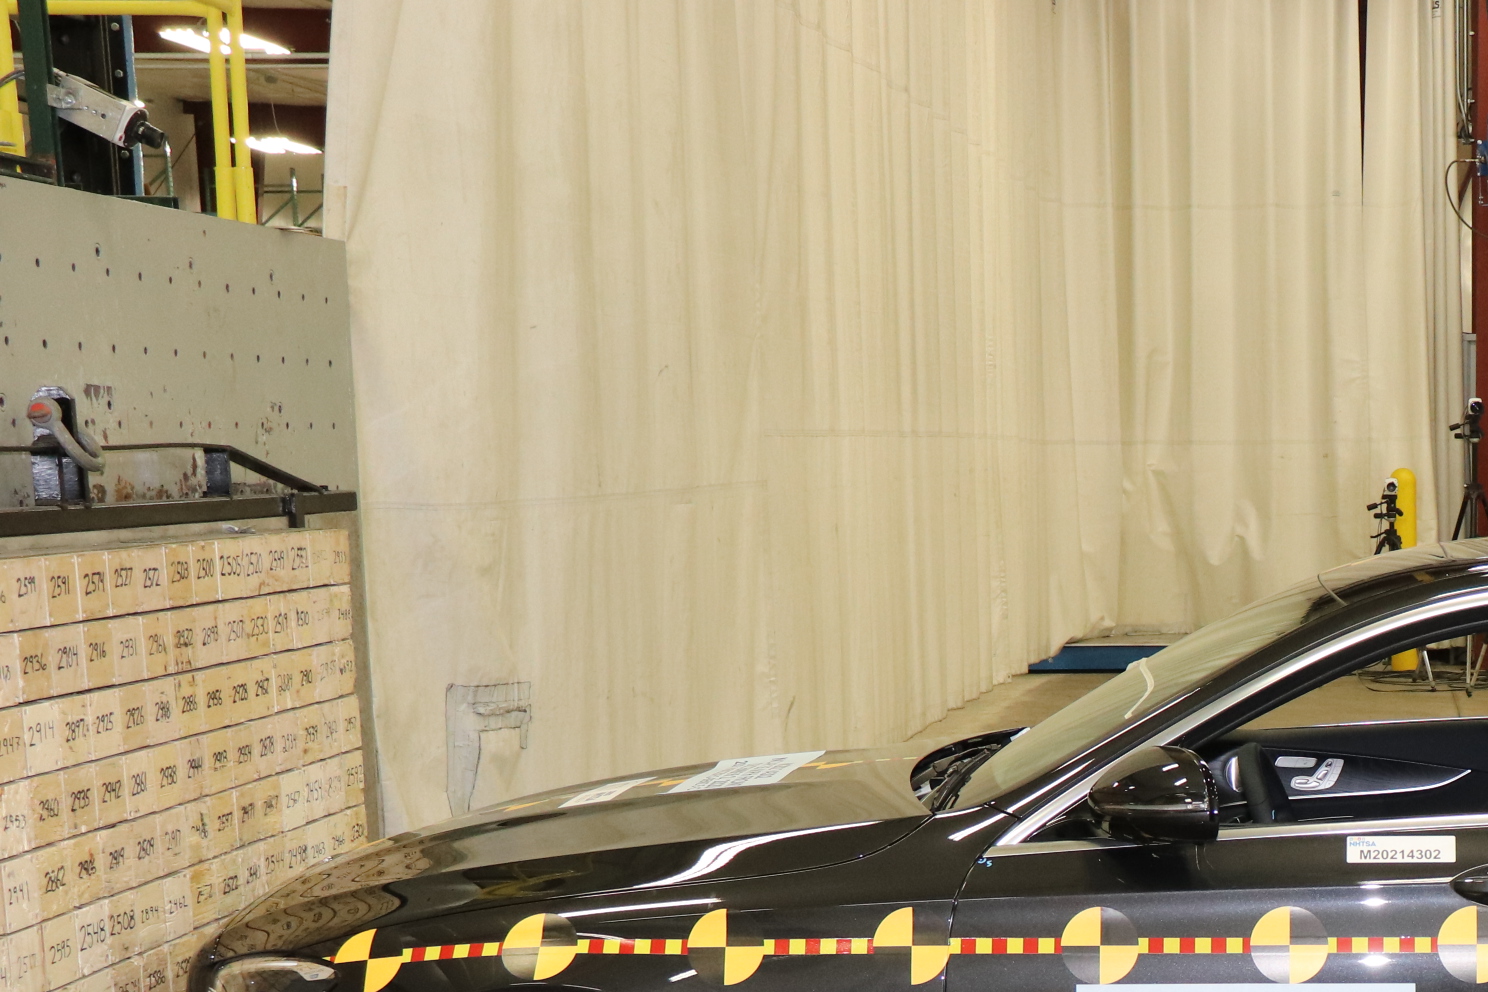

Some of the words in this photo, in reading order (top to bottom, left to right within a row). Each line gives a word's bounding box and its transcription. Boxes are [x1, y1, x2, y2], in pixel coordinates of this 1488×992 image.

[114, 567, 133, 588] 2527
[143, 567, 161, 588] 2572
[170, 561, 189, 583] 2503
[197, 556, 214, 579] 2500
[50, 576, 70, 599] 2591
[250, 616, 269, 638] 2530
[89, 642, 107, 662] 2916
[120, 638, 136, 659] 2931
[23, 653, 47, 675] 2936
[28, 720, 54, 747] 2914
[71, 788, 91, 812] 2935
[102, 780, 122, 803] 2942
[1360, 850, 1441, 860] M20214302
[9, 880, 30, 905] 2941
[141, 906, 159, 924] 2894
[169, 896, 188, 914] 2462
[110, 909, 136, 936] 2508
[80, 919, 106, 952] 2548
[51, 939, 71, 965] 2595
